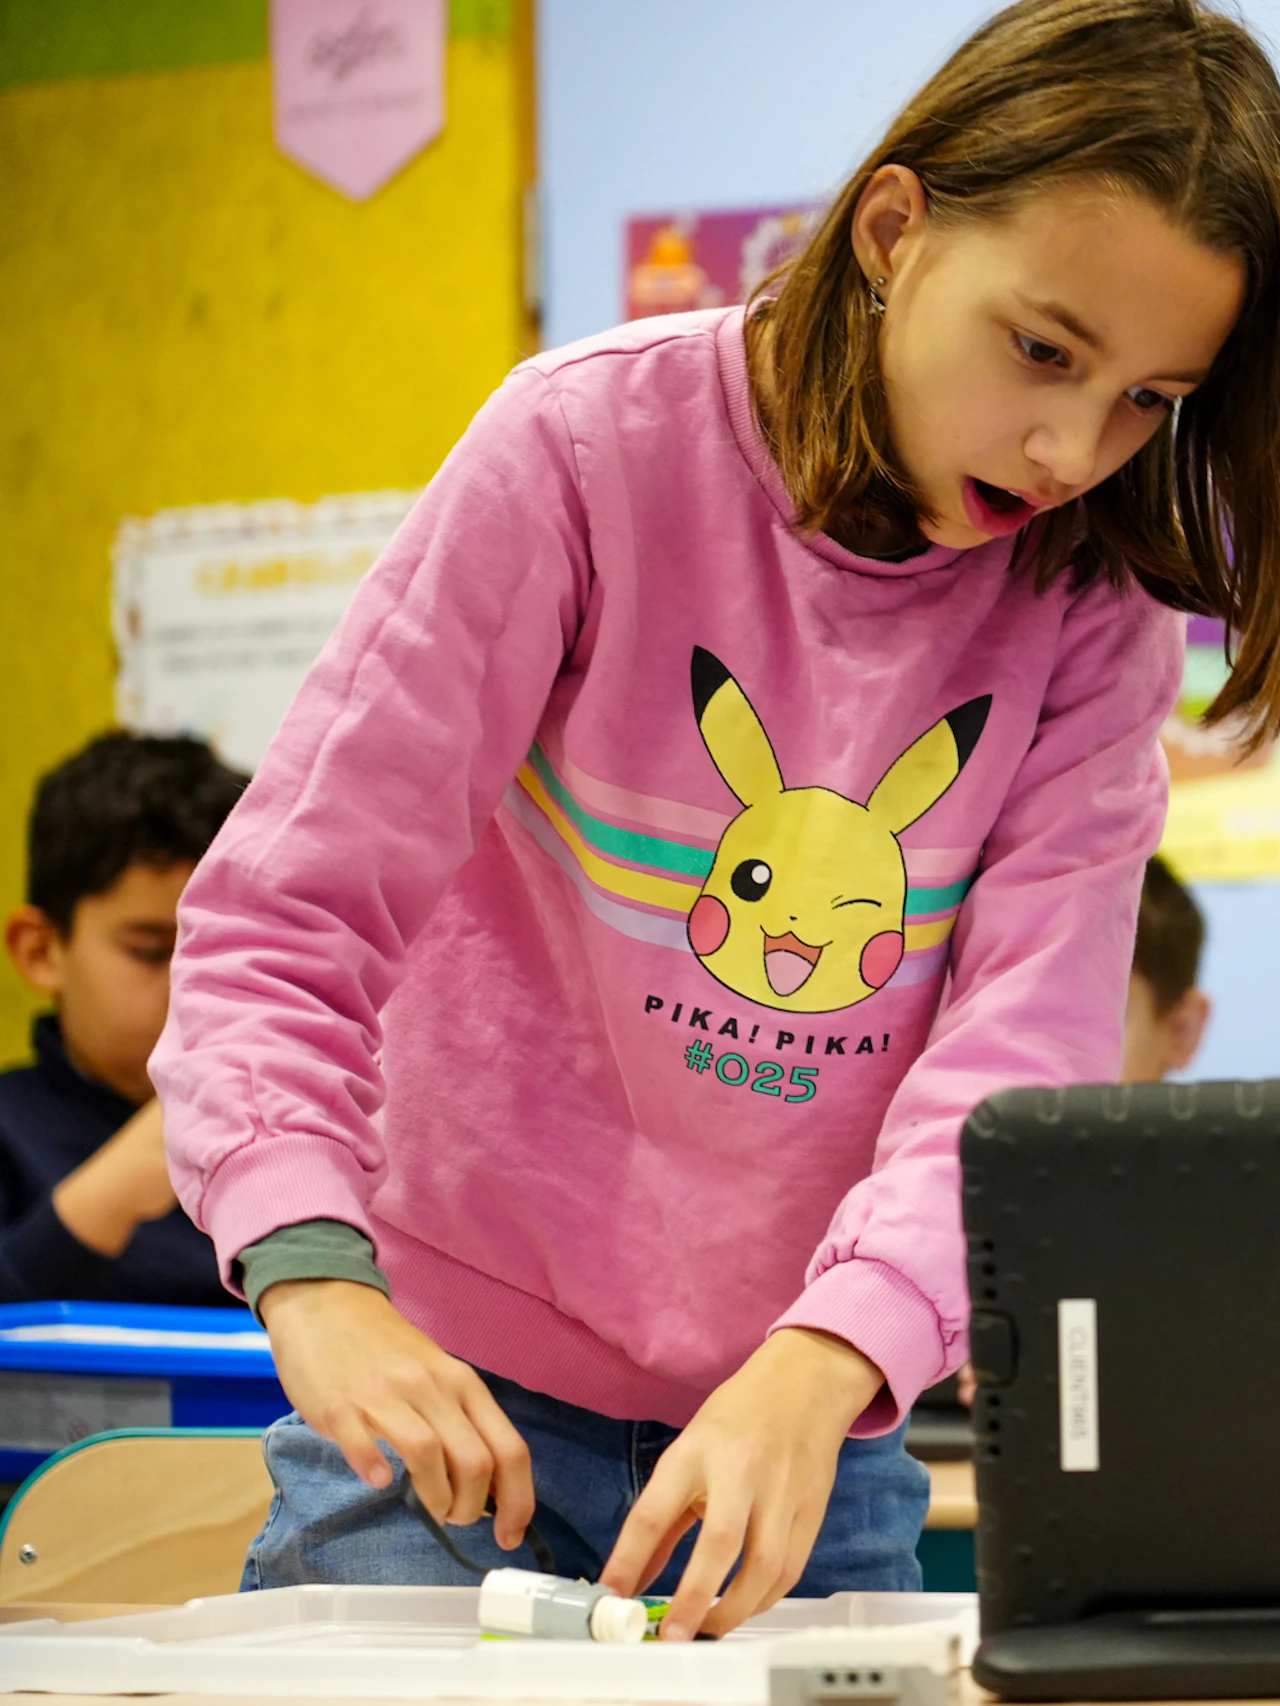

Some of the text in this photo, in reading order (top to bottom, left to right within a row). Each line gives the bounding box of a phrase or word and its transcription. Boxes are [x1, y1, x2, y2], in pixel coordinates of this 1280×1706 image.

[644, 994, 890, 1055] PIKA! PIKA!
[684, 1039, 819, 1103] #025
